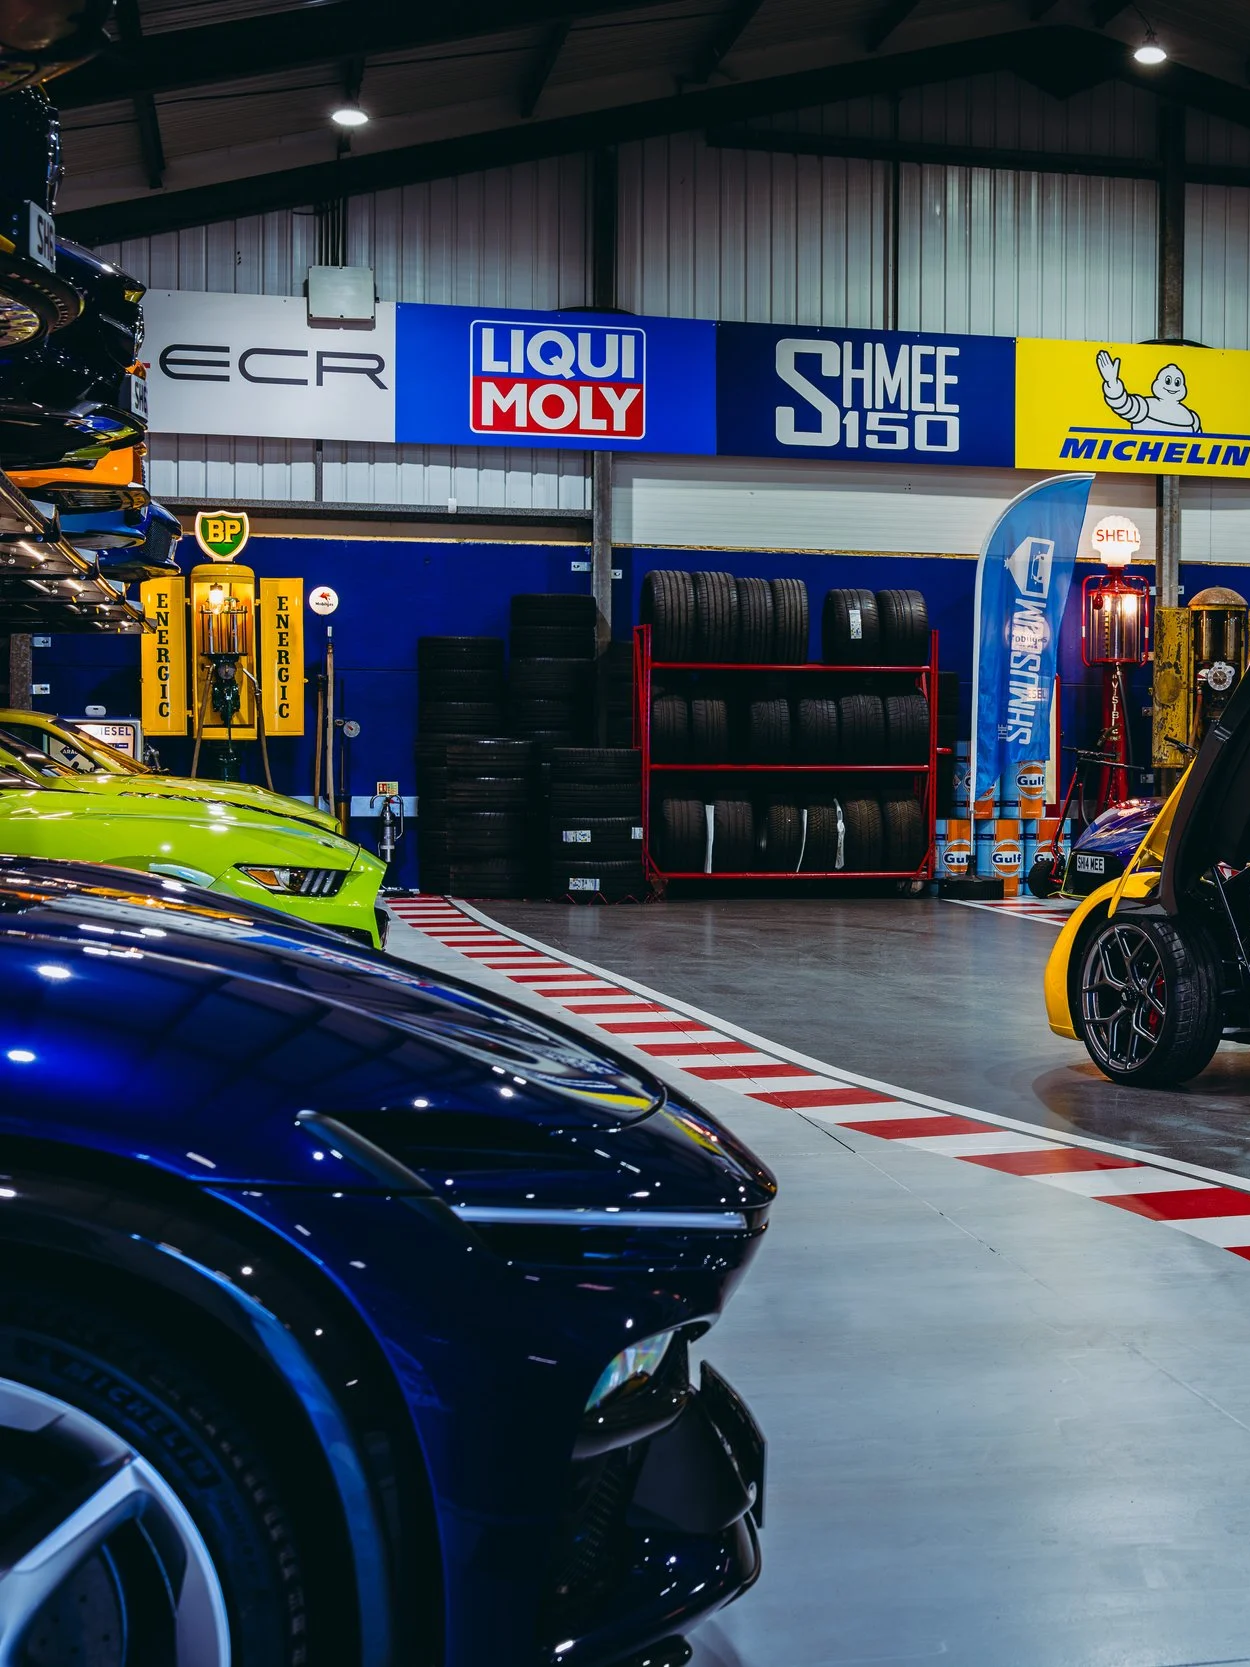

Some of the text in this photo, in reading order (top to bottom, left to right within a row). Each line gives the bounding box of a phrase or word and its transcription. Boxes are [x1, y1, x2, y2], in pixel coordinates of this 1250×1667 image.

[159, 343, 389, 390] ECR
[481, 327, 636, 380] LIQUI
[481, 381, 641, 432] MOLY
[775, 338, 960, 447] SHMEE
[842, 410, 960, 453] 150
[206, 519, 242, 544] BP
[1096, 529, 1140, 543] SHELL
[156, 593, 171, 718] ENERGIC
[275, 596, 291, 719] ENERGIC
[95, 726, 132, 736] IESEL
[1017, 775, 1045, 786] Gulf
[943, 854, 969, 864] Gul
[992, 853, 1022, 864] Gulf
[1090, 857, 1104, 871] MEE
